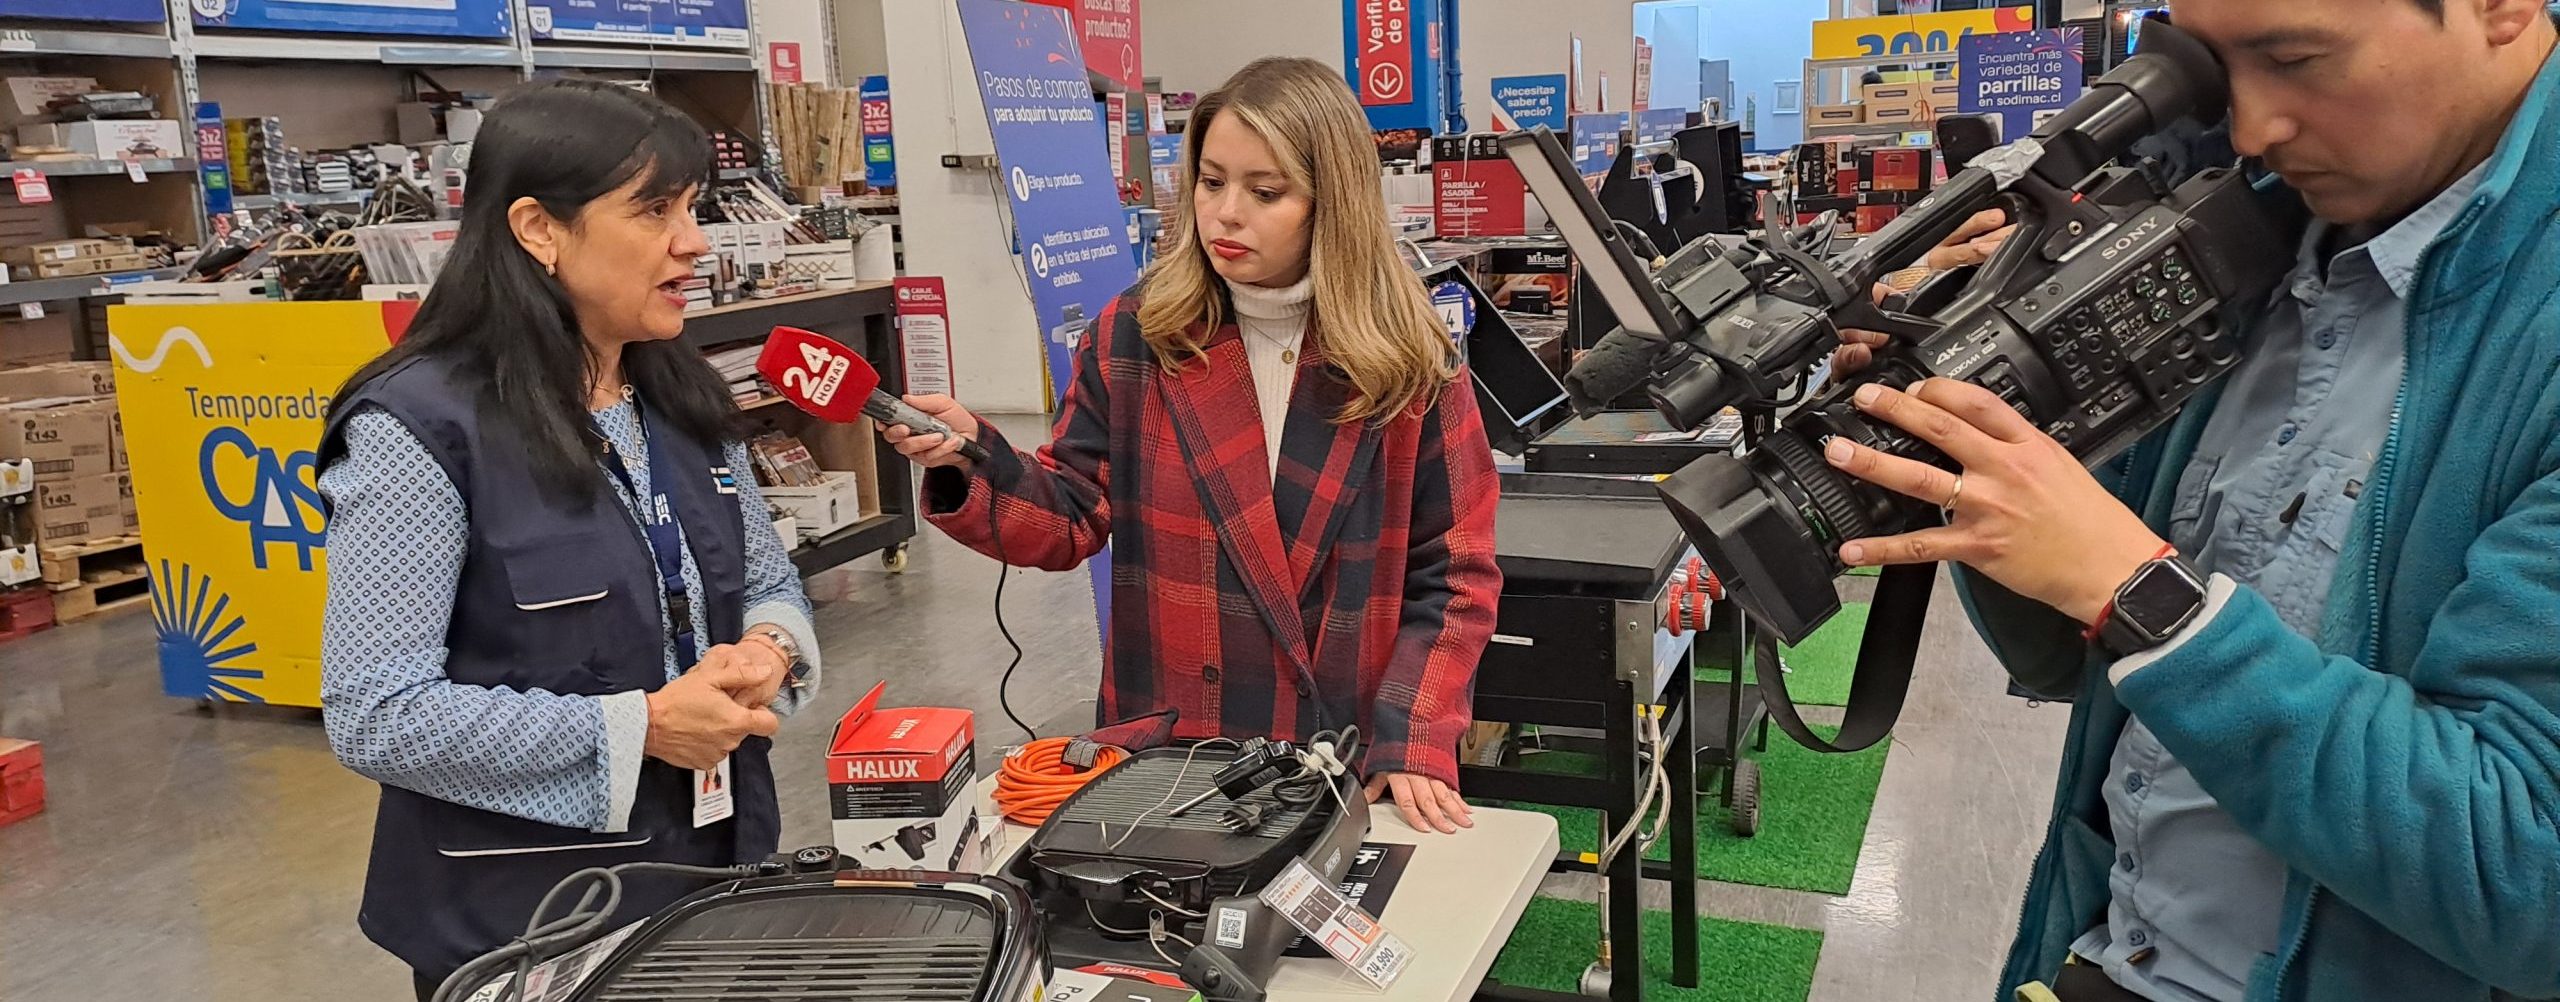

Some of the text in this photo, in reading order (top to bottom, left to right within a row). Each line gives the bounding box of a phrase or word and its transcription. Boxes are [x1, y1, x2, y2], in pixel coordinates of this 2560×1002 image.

[535, 17, 547, 28] 01
[1085, 14, 1132, 42] productos?
[1366, 0, 1384, 54] Verifi
[1386, 0, 1406, 44] de p
[1978, 50, 2062, 65] Encuentra más
[1979, 60, 2062, 77] variedad de
[983, 70, 1089, 104] Pasos de compra
[1497, 85, 1556, 99] ¿Necesitas
[1978, 74, 2062, 98] parrillas
[863, 102, 889, 119] 3x2
[1507, 96, 1549, 107] saber el
[1978, 93, 2062, 108] en sodimac.cl
[993, 104, 1094, 126] para adquirir tu producto
[1513, 106, 1553, 119] precio?
[199, 128, 222, 146] 3x2
[1015, 170, 1084, 198] 1 Elige tu producto.
[1441, 181, 1480, 189] PARRILLA
[1441, 189, 1475, 197] ASADOR
[1042, 224, 1110, 247] Identifica su ubicación
[2101, 216, 2158, 260] SONY
[1034, 243, 1118, 274] 2 en la ficha del producto
[1445, 309, 1456, 328] 4
[1936, 341, 1966, 366] 4K
[782, 342, 833, 400] 24
[817, 360, 845, 402] HORAS
[184, 387, 332, 428] Temporada
[199, 426, 329, 572] CAS
[654, 492, 672, 526] SEC
[945, 728, 967, 767] HALUX
[847, 759, 920, 780] HALUX
[1103, 965, 1151, 977] HALUX
[1366, 947, 1395, 979] 34.990
[1050, 985, 1085, 1002] Pa
